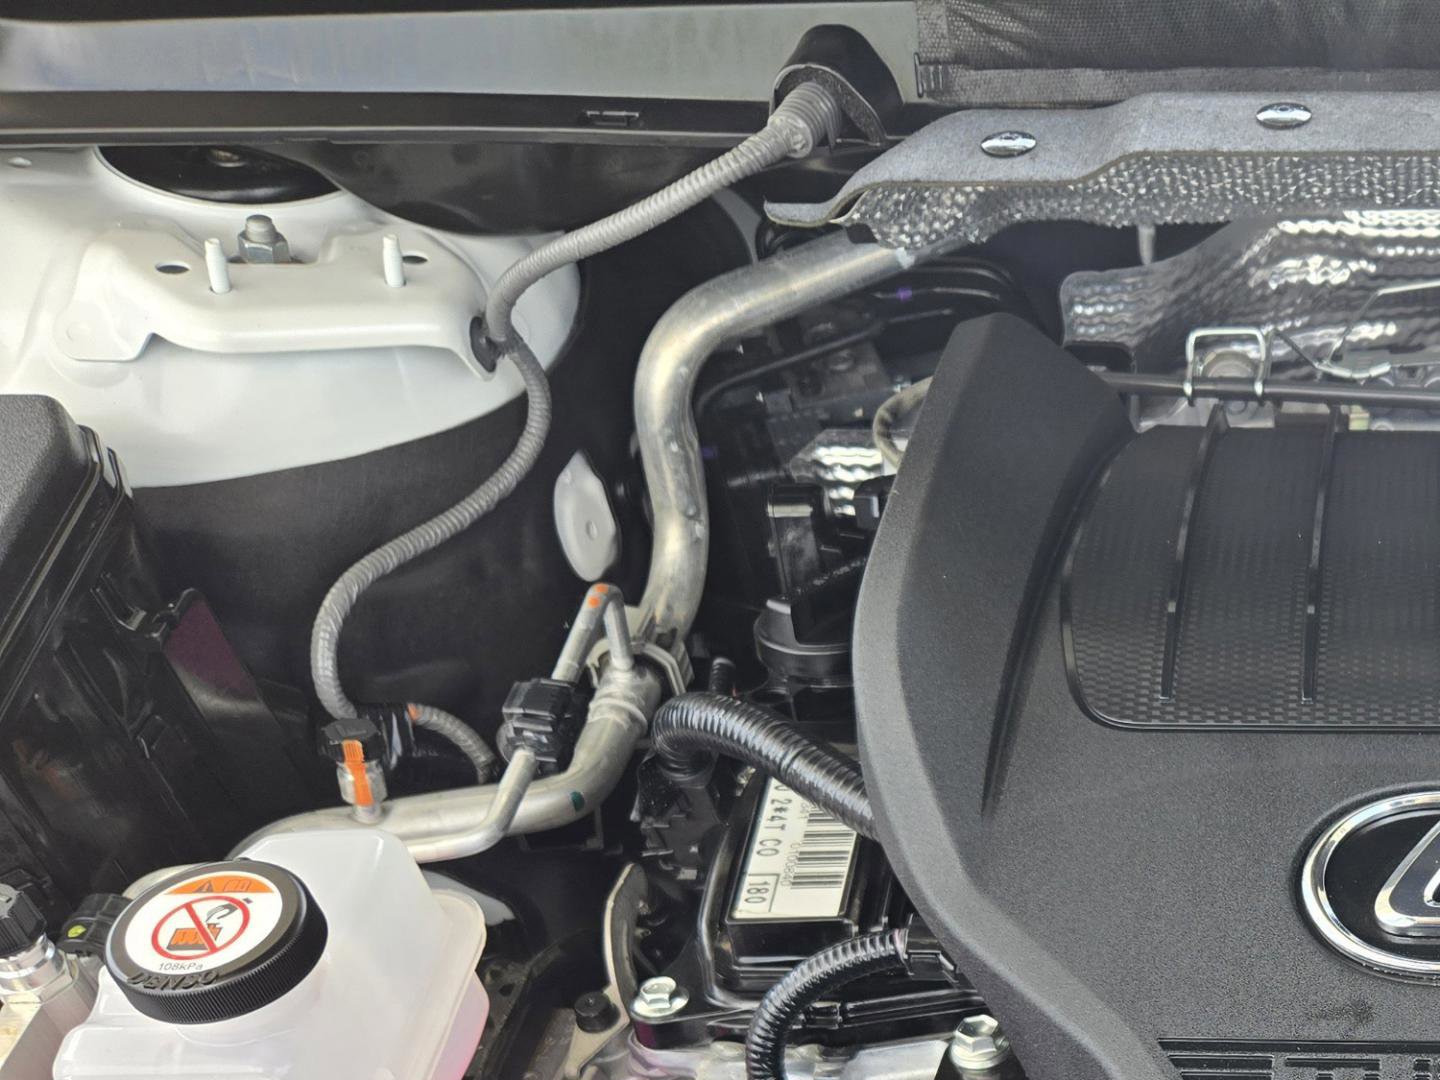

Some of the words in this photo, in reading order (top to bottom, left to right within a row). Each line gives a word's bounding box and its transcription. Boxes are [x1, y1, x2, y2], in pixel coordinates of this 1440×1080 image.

[743, 880, 771, 904] 180
[158, 962, 204, 972] 108kPa
[127, 970, 221, 991] DENSO
